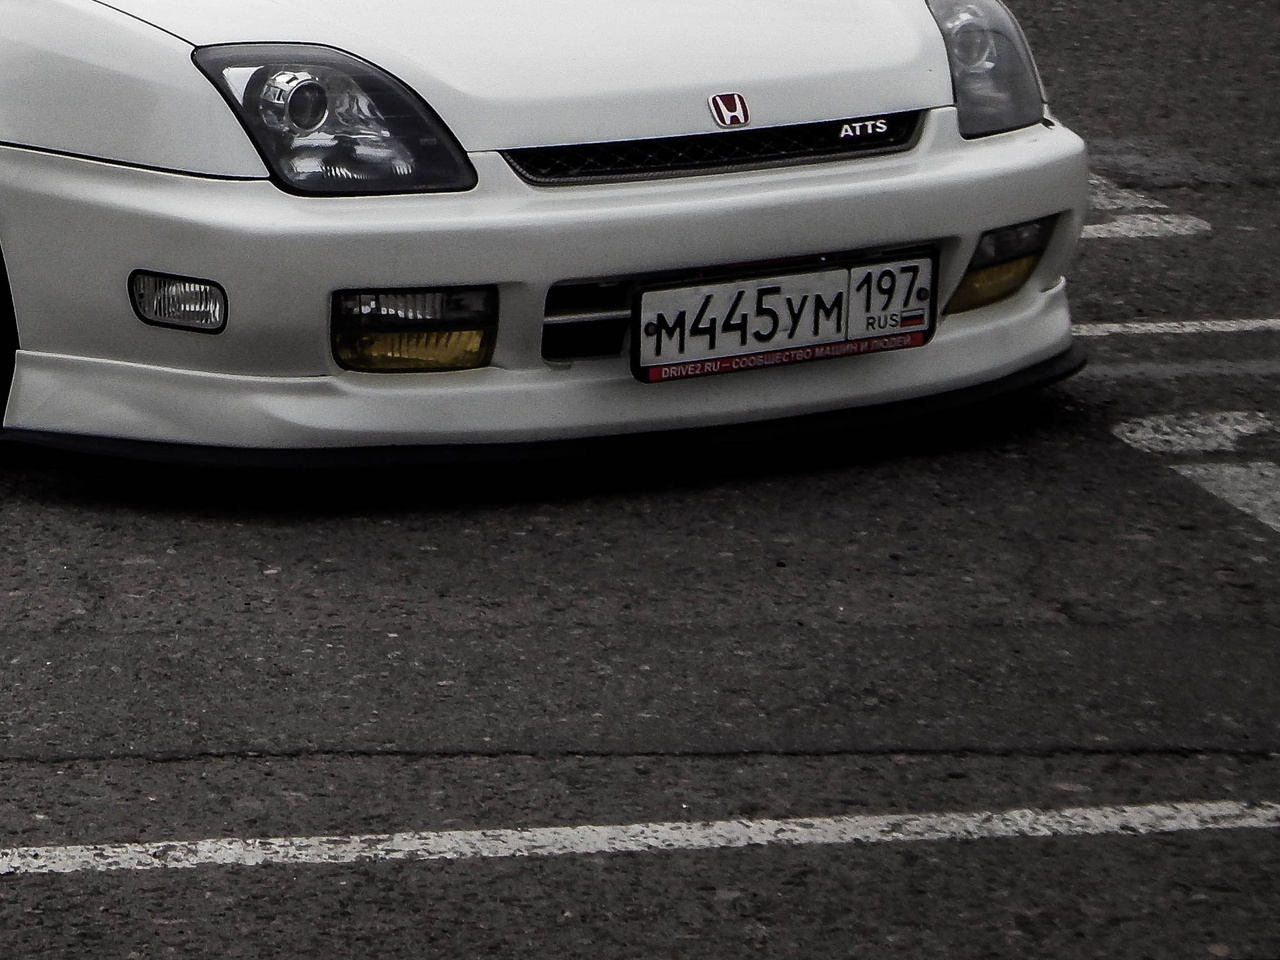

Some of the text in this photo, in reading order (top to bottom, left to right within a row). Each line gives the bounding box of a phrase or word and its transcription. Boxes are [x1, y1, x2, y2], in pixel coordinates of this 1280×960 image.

[840, 119, 888, 138] ATTS
[856, 265, 919, 312] 197
[866, 313, 899, 331] RUS
[731, 348, 812, 369] СООБЩЕСТВО
